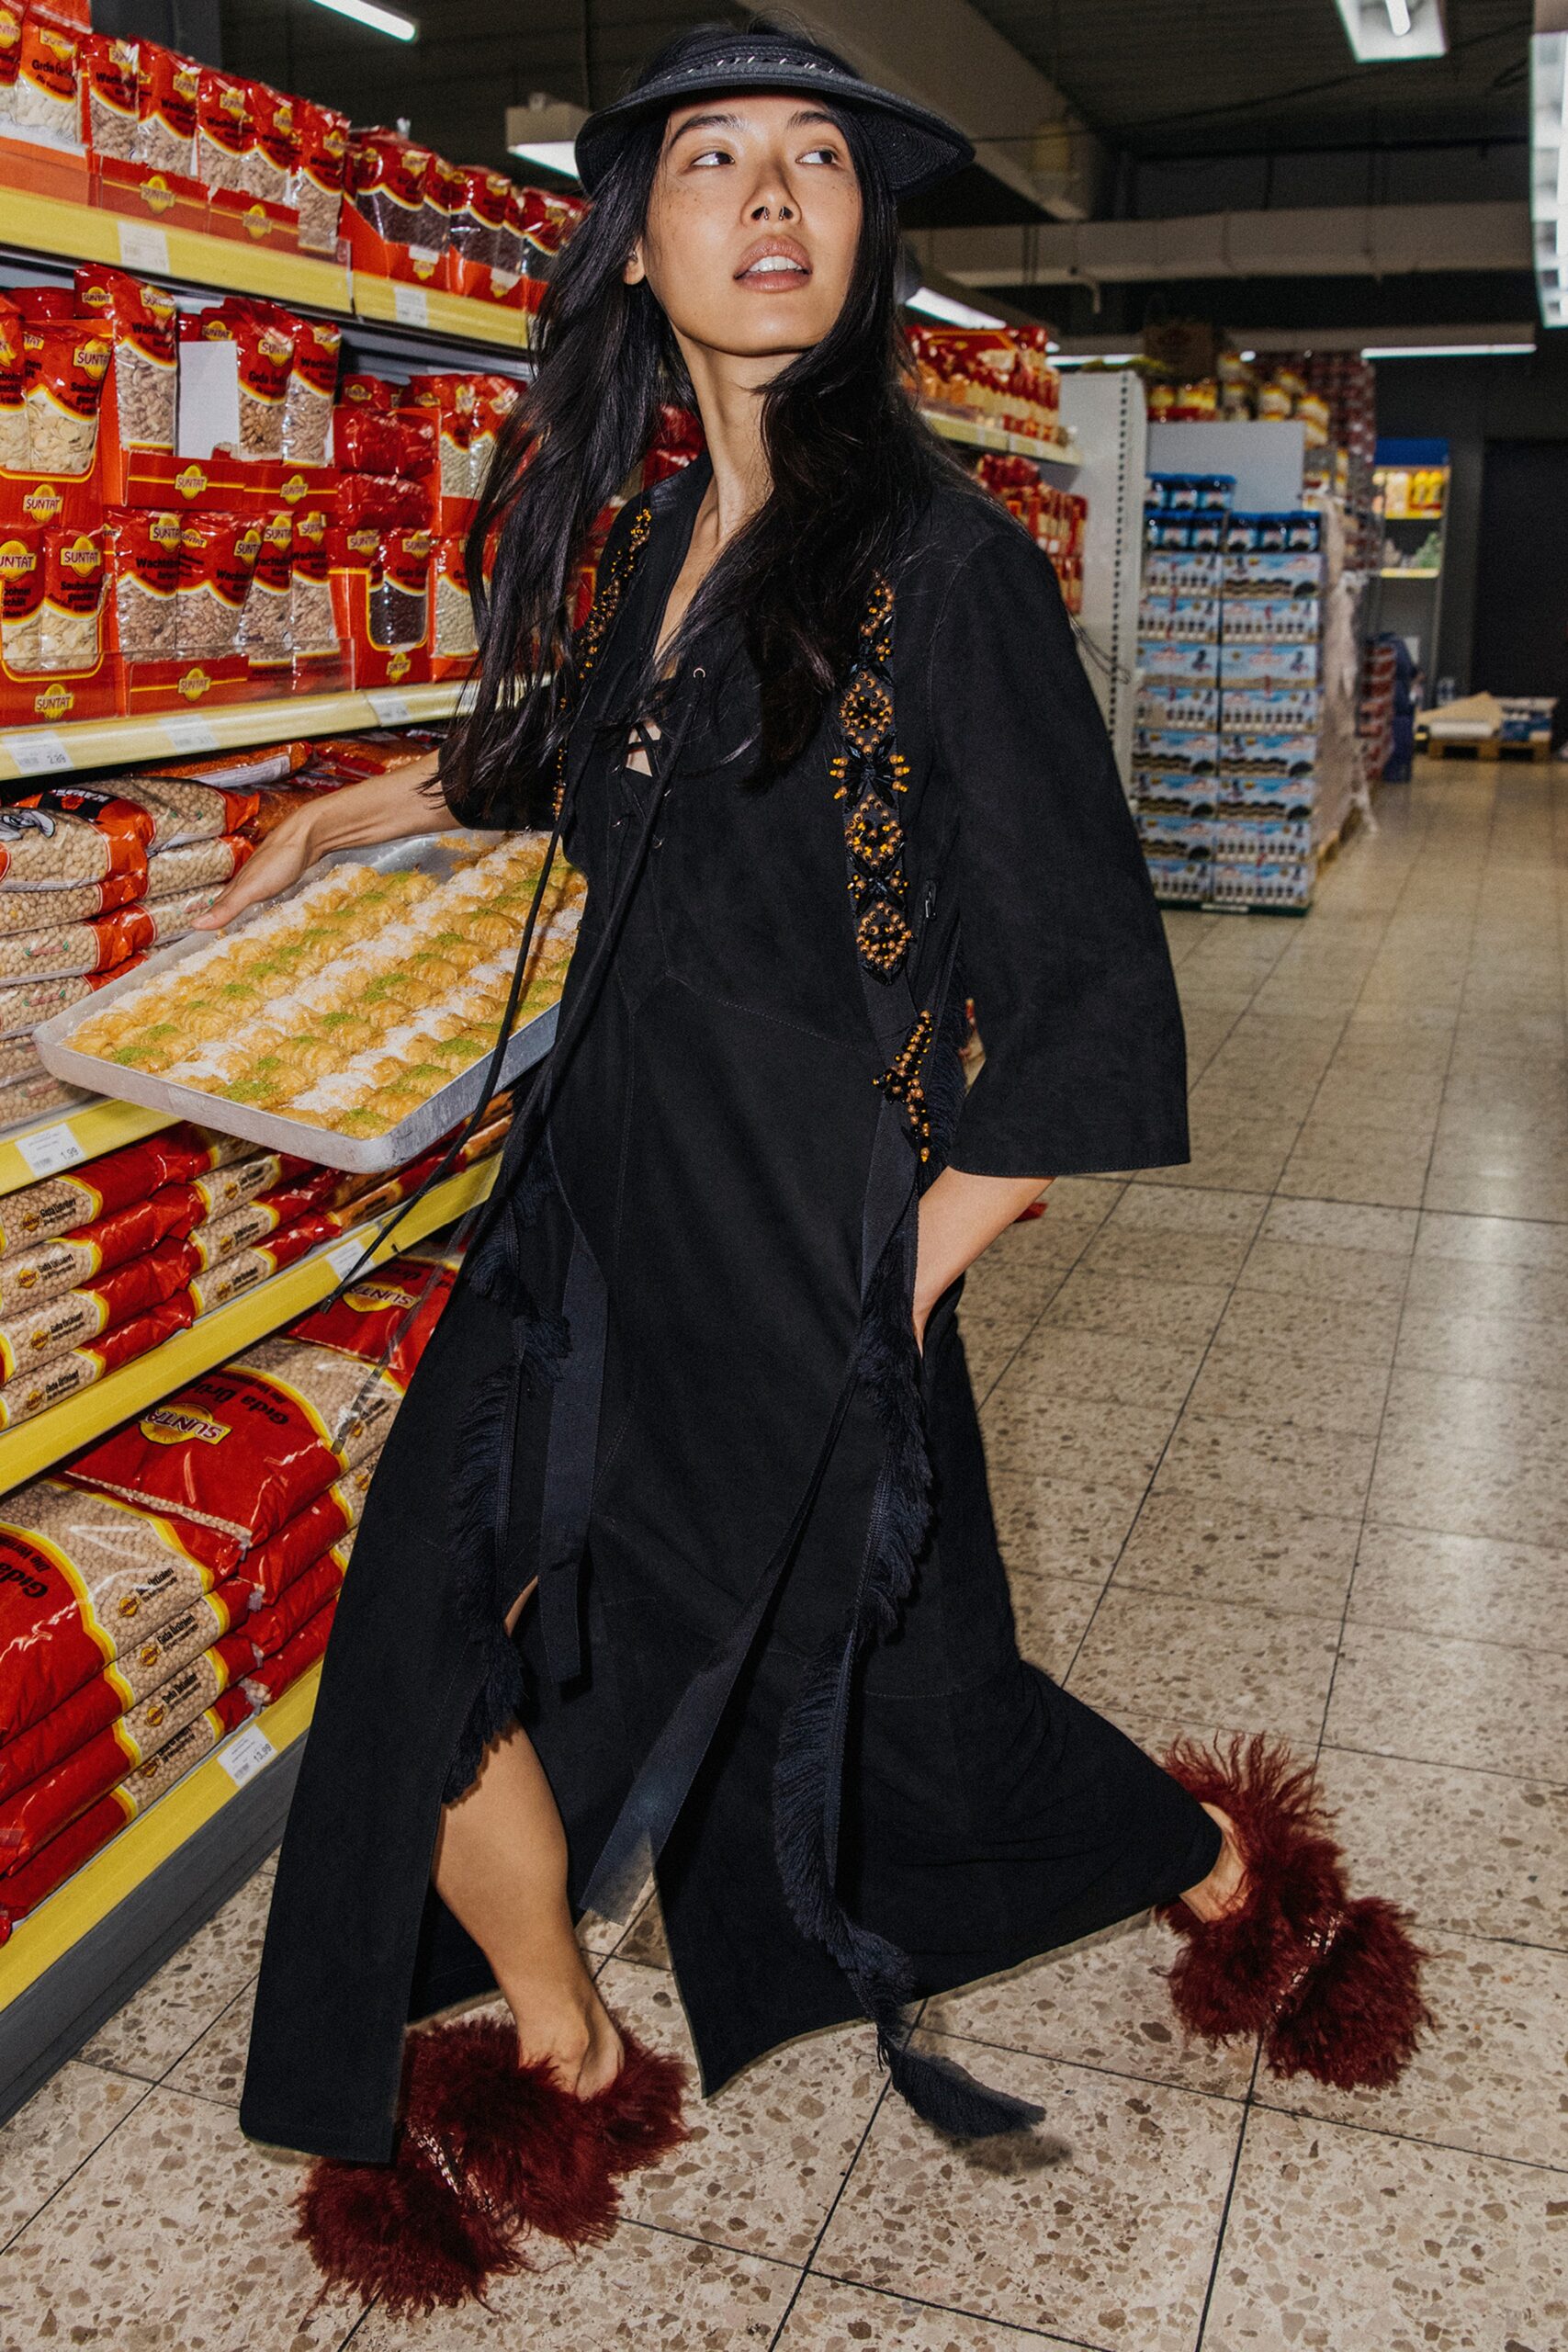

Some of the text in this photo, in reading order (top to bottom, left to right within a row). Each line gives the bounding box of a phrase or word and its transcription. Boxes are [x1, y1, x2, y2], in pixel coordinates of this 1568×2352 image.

[27, 498, 61, 511] SUNTAT
[0, 555, 34, 569] UNTAT
[64, 551, 98, 563] SUNTAT
[37, 696, 71, 710] SUNTAT
[350, 1284, 413, 1306] SUNTA
[146, 1409, 223, 1440] SUNTA
